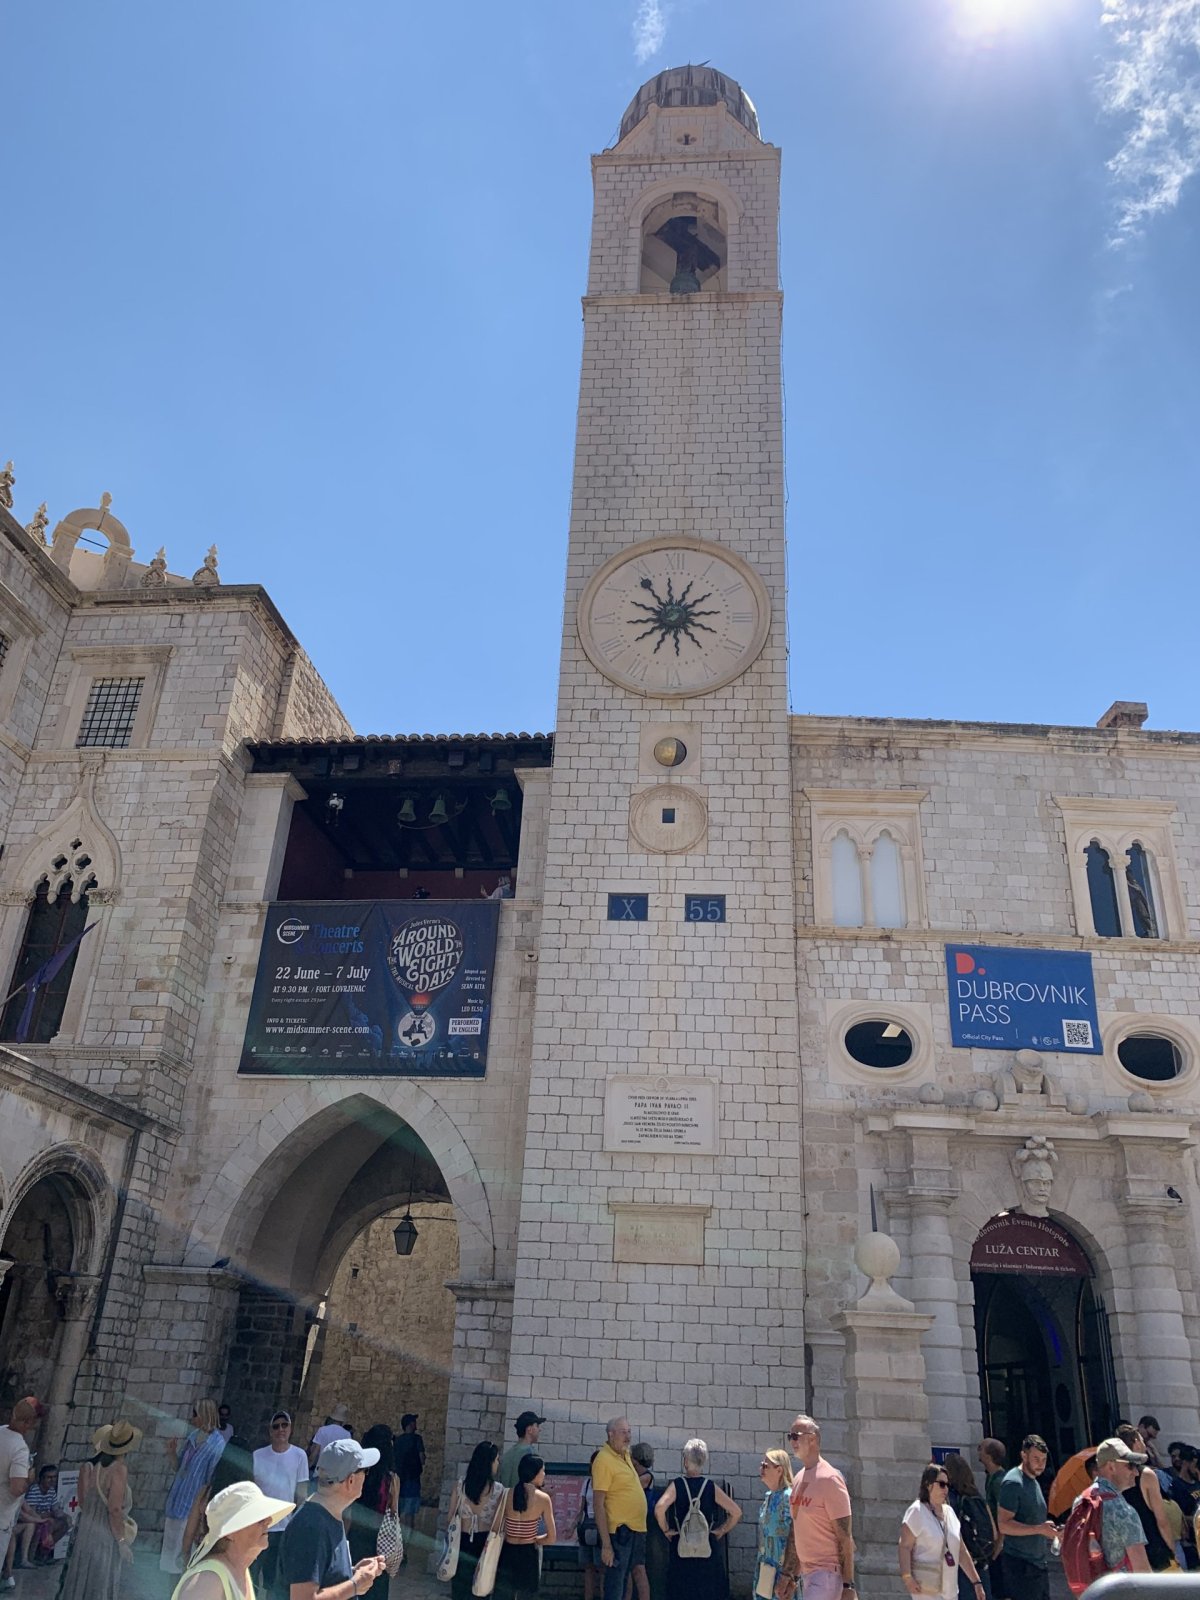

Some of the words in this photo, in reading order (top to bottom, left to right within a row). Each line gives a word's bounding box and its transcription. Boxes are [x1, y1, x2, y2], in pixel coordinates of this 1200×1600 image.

[620, 898, 637, 920] X
[689, 900, 721, 921] 55
[312, 923, 360, 938] Theatre
[392, 924, 457, 950] AROUND
[309, 940, 364, 954] Concerts
[393, 938, 454, 968] WORLD
[274, 966, 292, 980] 22
[294, 966, 321, 980] June
[336, 966, 344, 979] 7
[346, 965, 372, 981] July
[406, 950, 464, 982] EIGHTY
[315, 984, 331, 993] FORT
[331, 984, 367, 993] LOVRJENAC
[415, 965, 456, 993] DAYS
[957, 979, 1088, 1006] DUBROVNIK
[959, 1003, 1011, 1025] PASS
[265, 1024, 370, 1034] www.midsummer-scene.com
[981, 1034, 992, 1042] City
[1011, 1217, 1037, 1229] Events
[1037, 1221, 1070, 1248] Hotspots
[985, 1243, 1014, 1255] LUŽA
[1016, 1245, 1060, 1258] CENTAR
